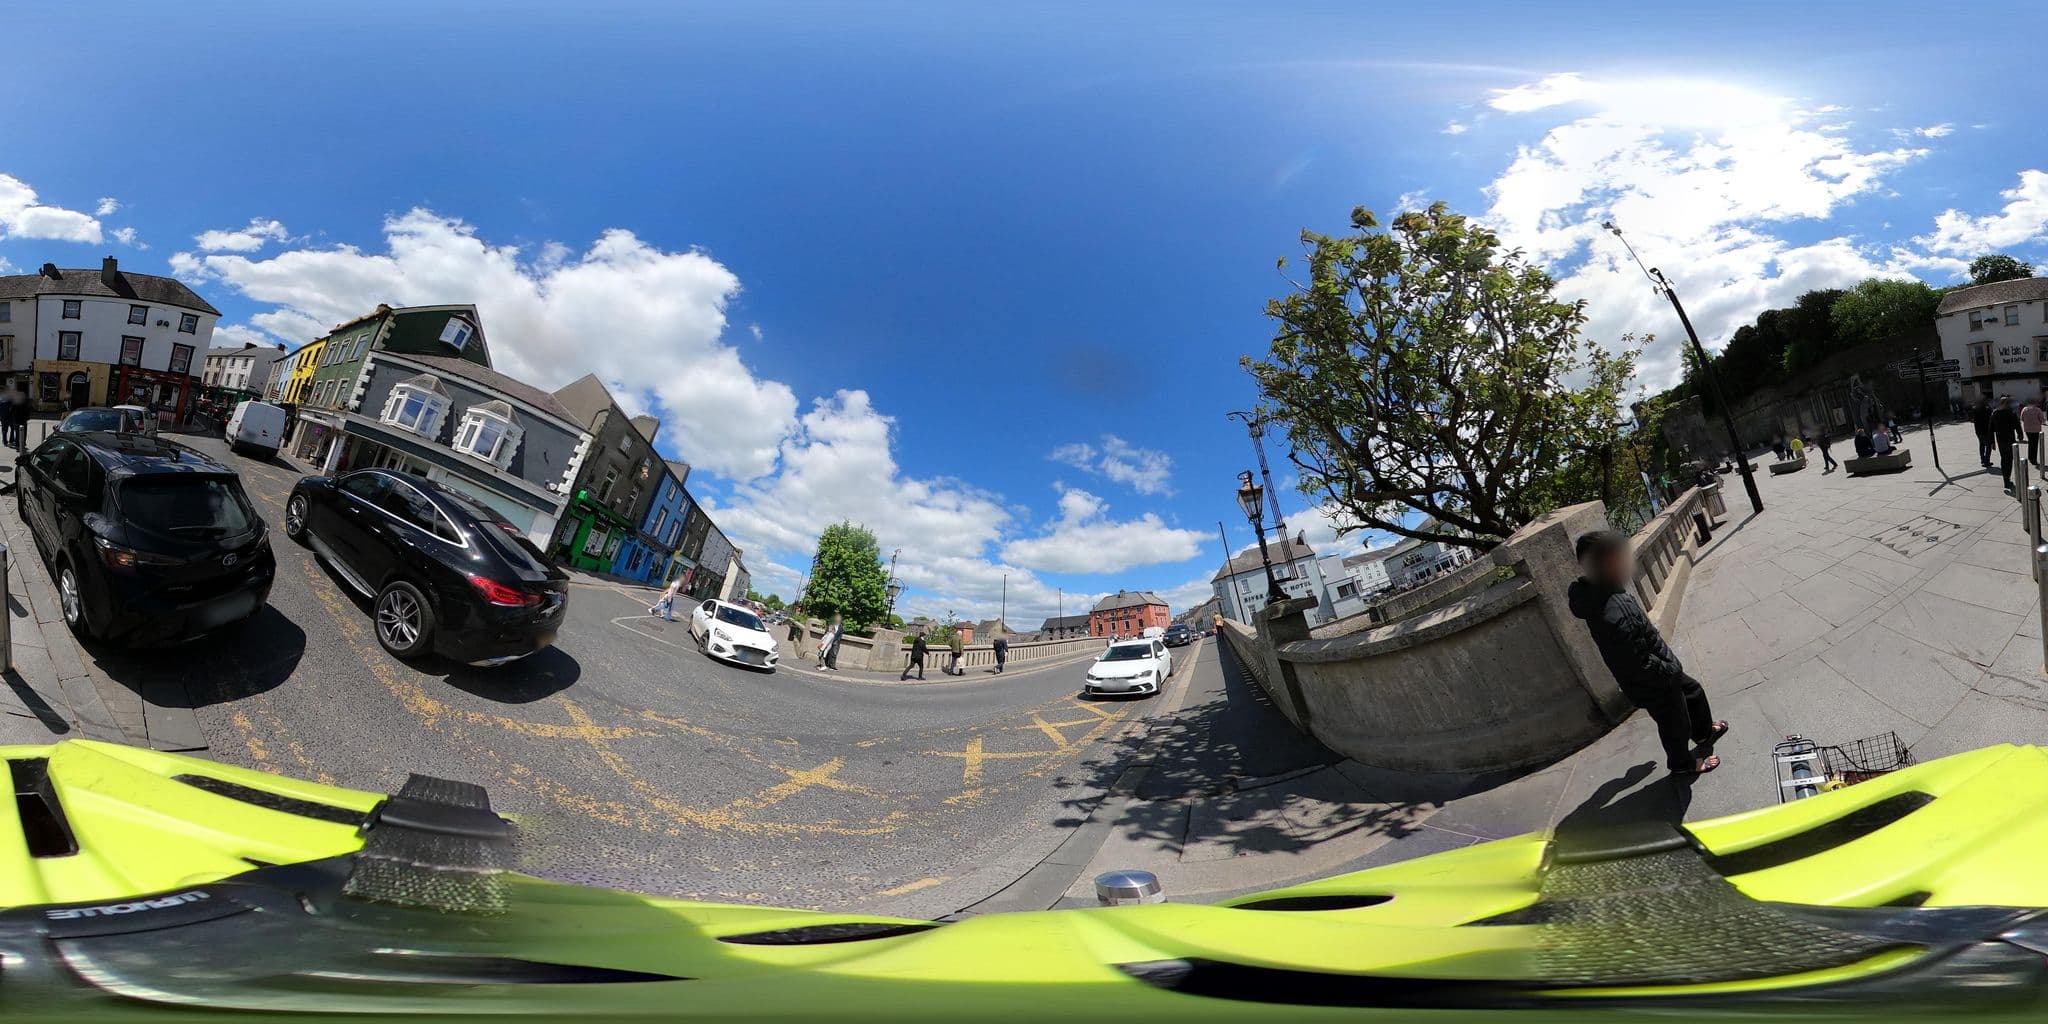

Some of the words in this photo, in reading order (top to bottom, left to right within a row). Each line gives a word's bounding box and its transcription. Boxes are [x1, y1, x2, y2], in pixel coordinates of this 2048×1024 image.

[1999, 346, 2010, 356] Wild
[1244, 593, 1264, 603] RIVER
[1290, 580, 1312, 591] HOTEL
